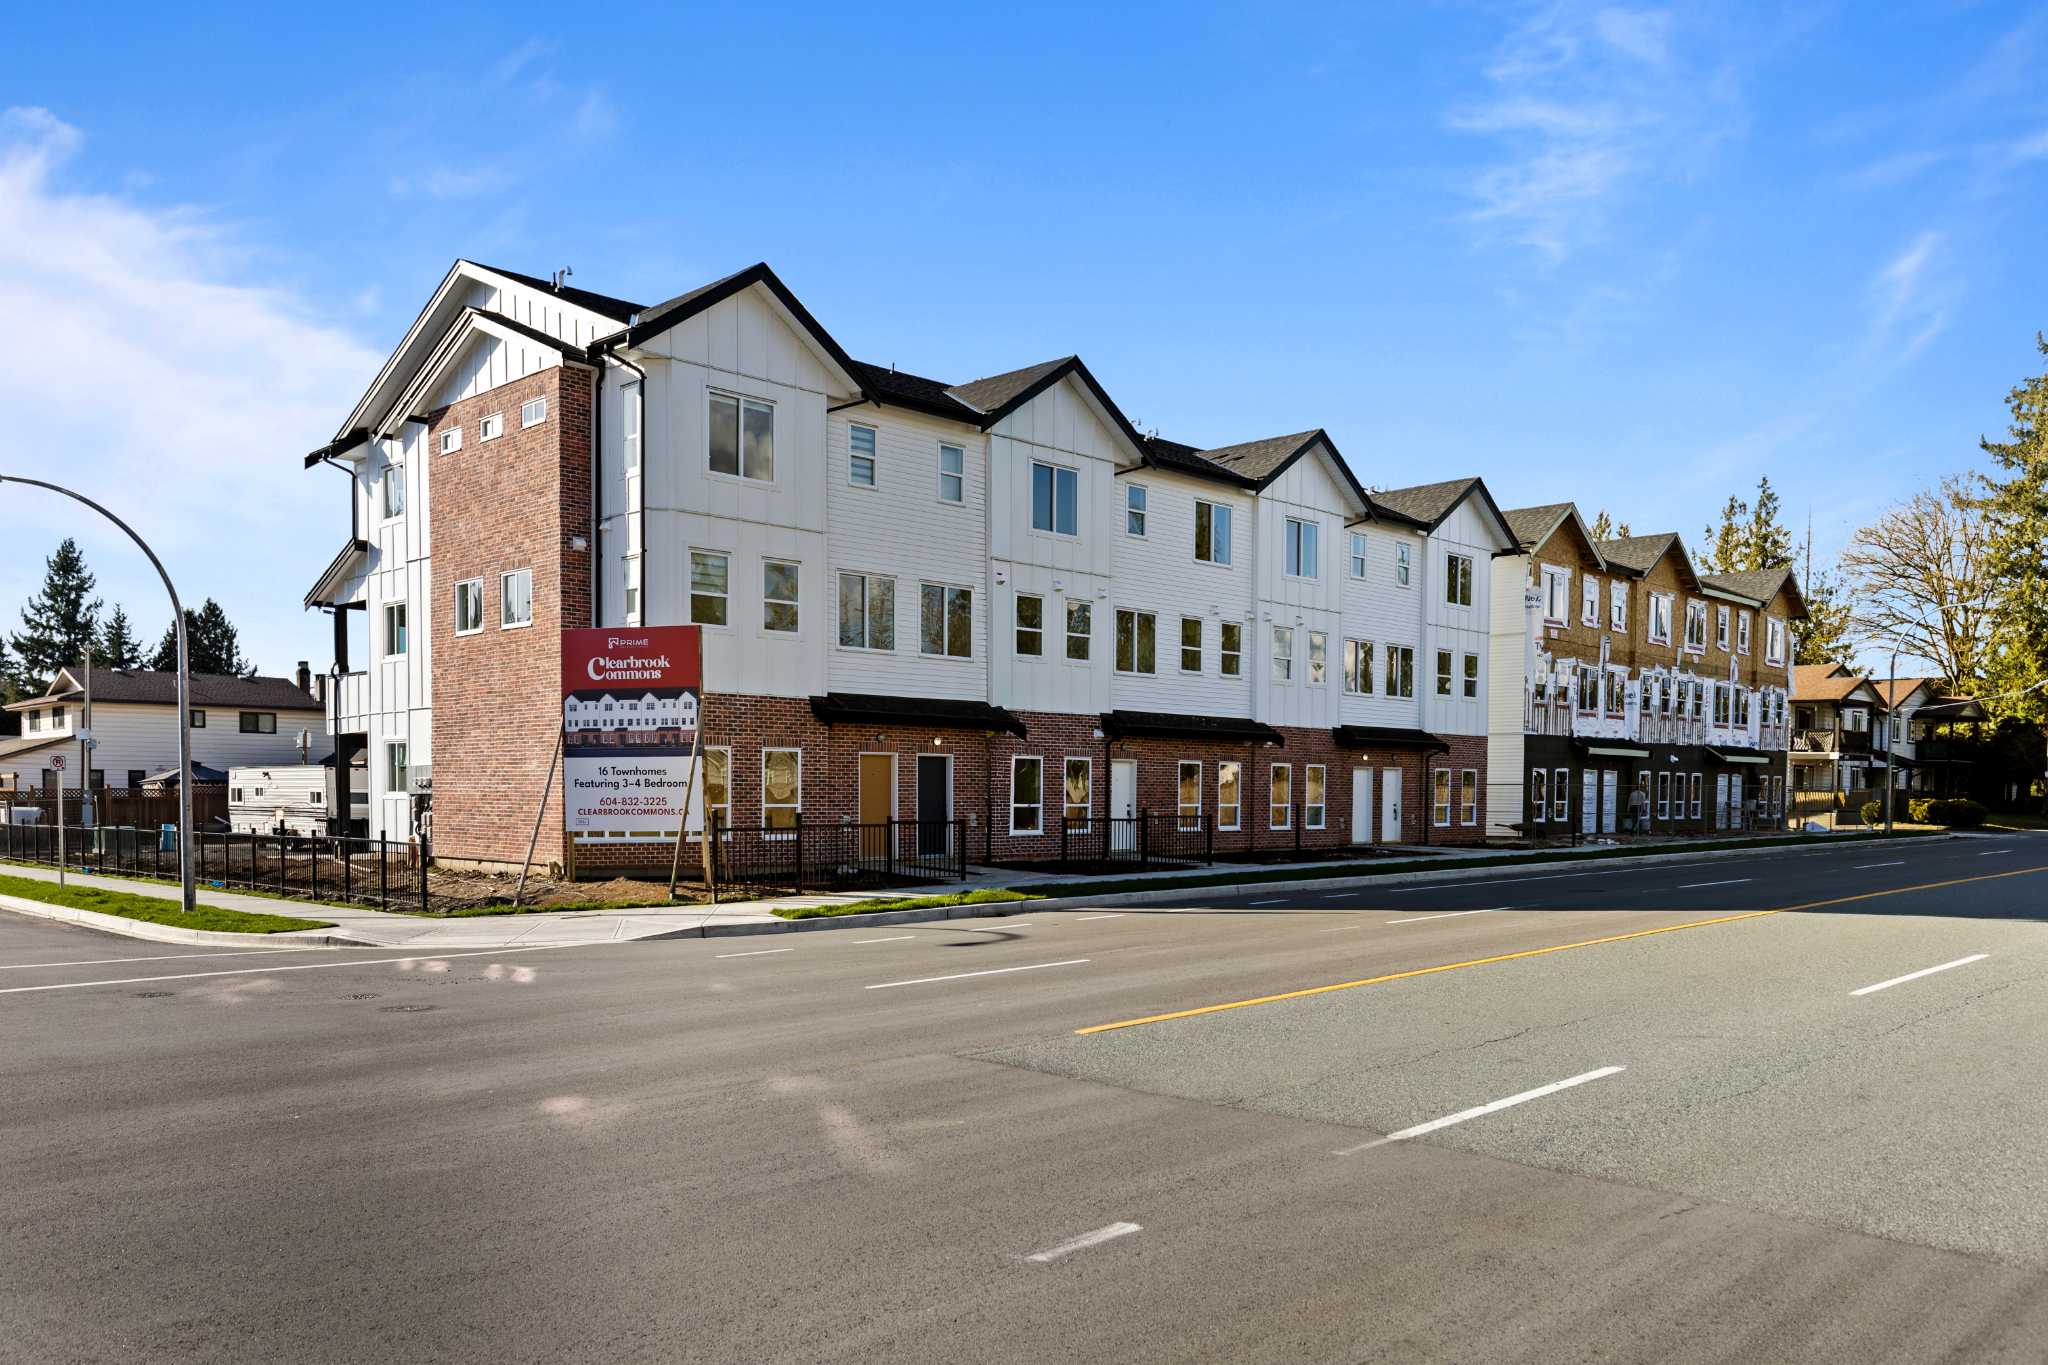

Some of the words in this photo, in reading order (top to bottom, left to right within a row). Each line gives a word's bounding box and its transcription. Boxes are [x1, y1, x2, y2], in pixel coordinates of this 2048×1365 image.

[620, 638, 649, 646] PRIME
[587, 655, 671, 676] Clearbrook
[598, 766, 608, 776] 16
[611, 766, 667, 776] Townhomes
[574, 779, 620, 790] Featuring
[599, 797, 667, 806] 604-832-3225
[577, 808, 690, 816] CLEARBROOKCOMMONS.C
